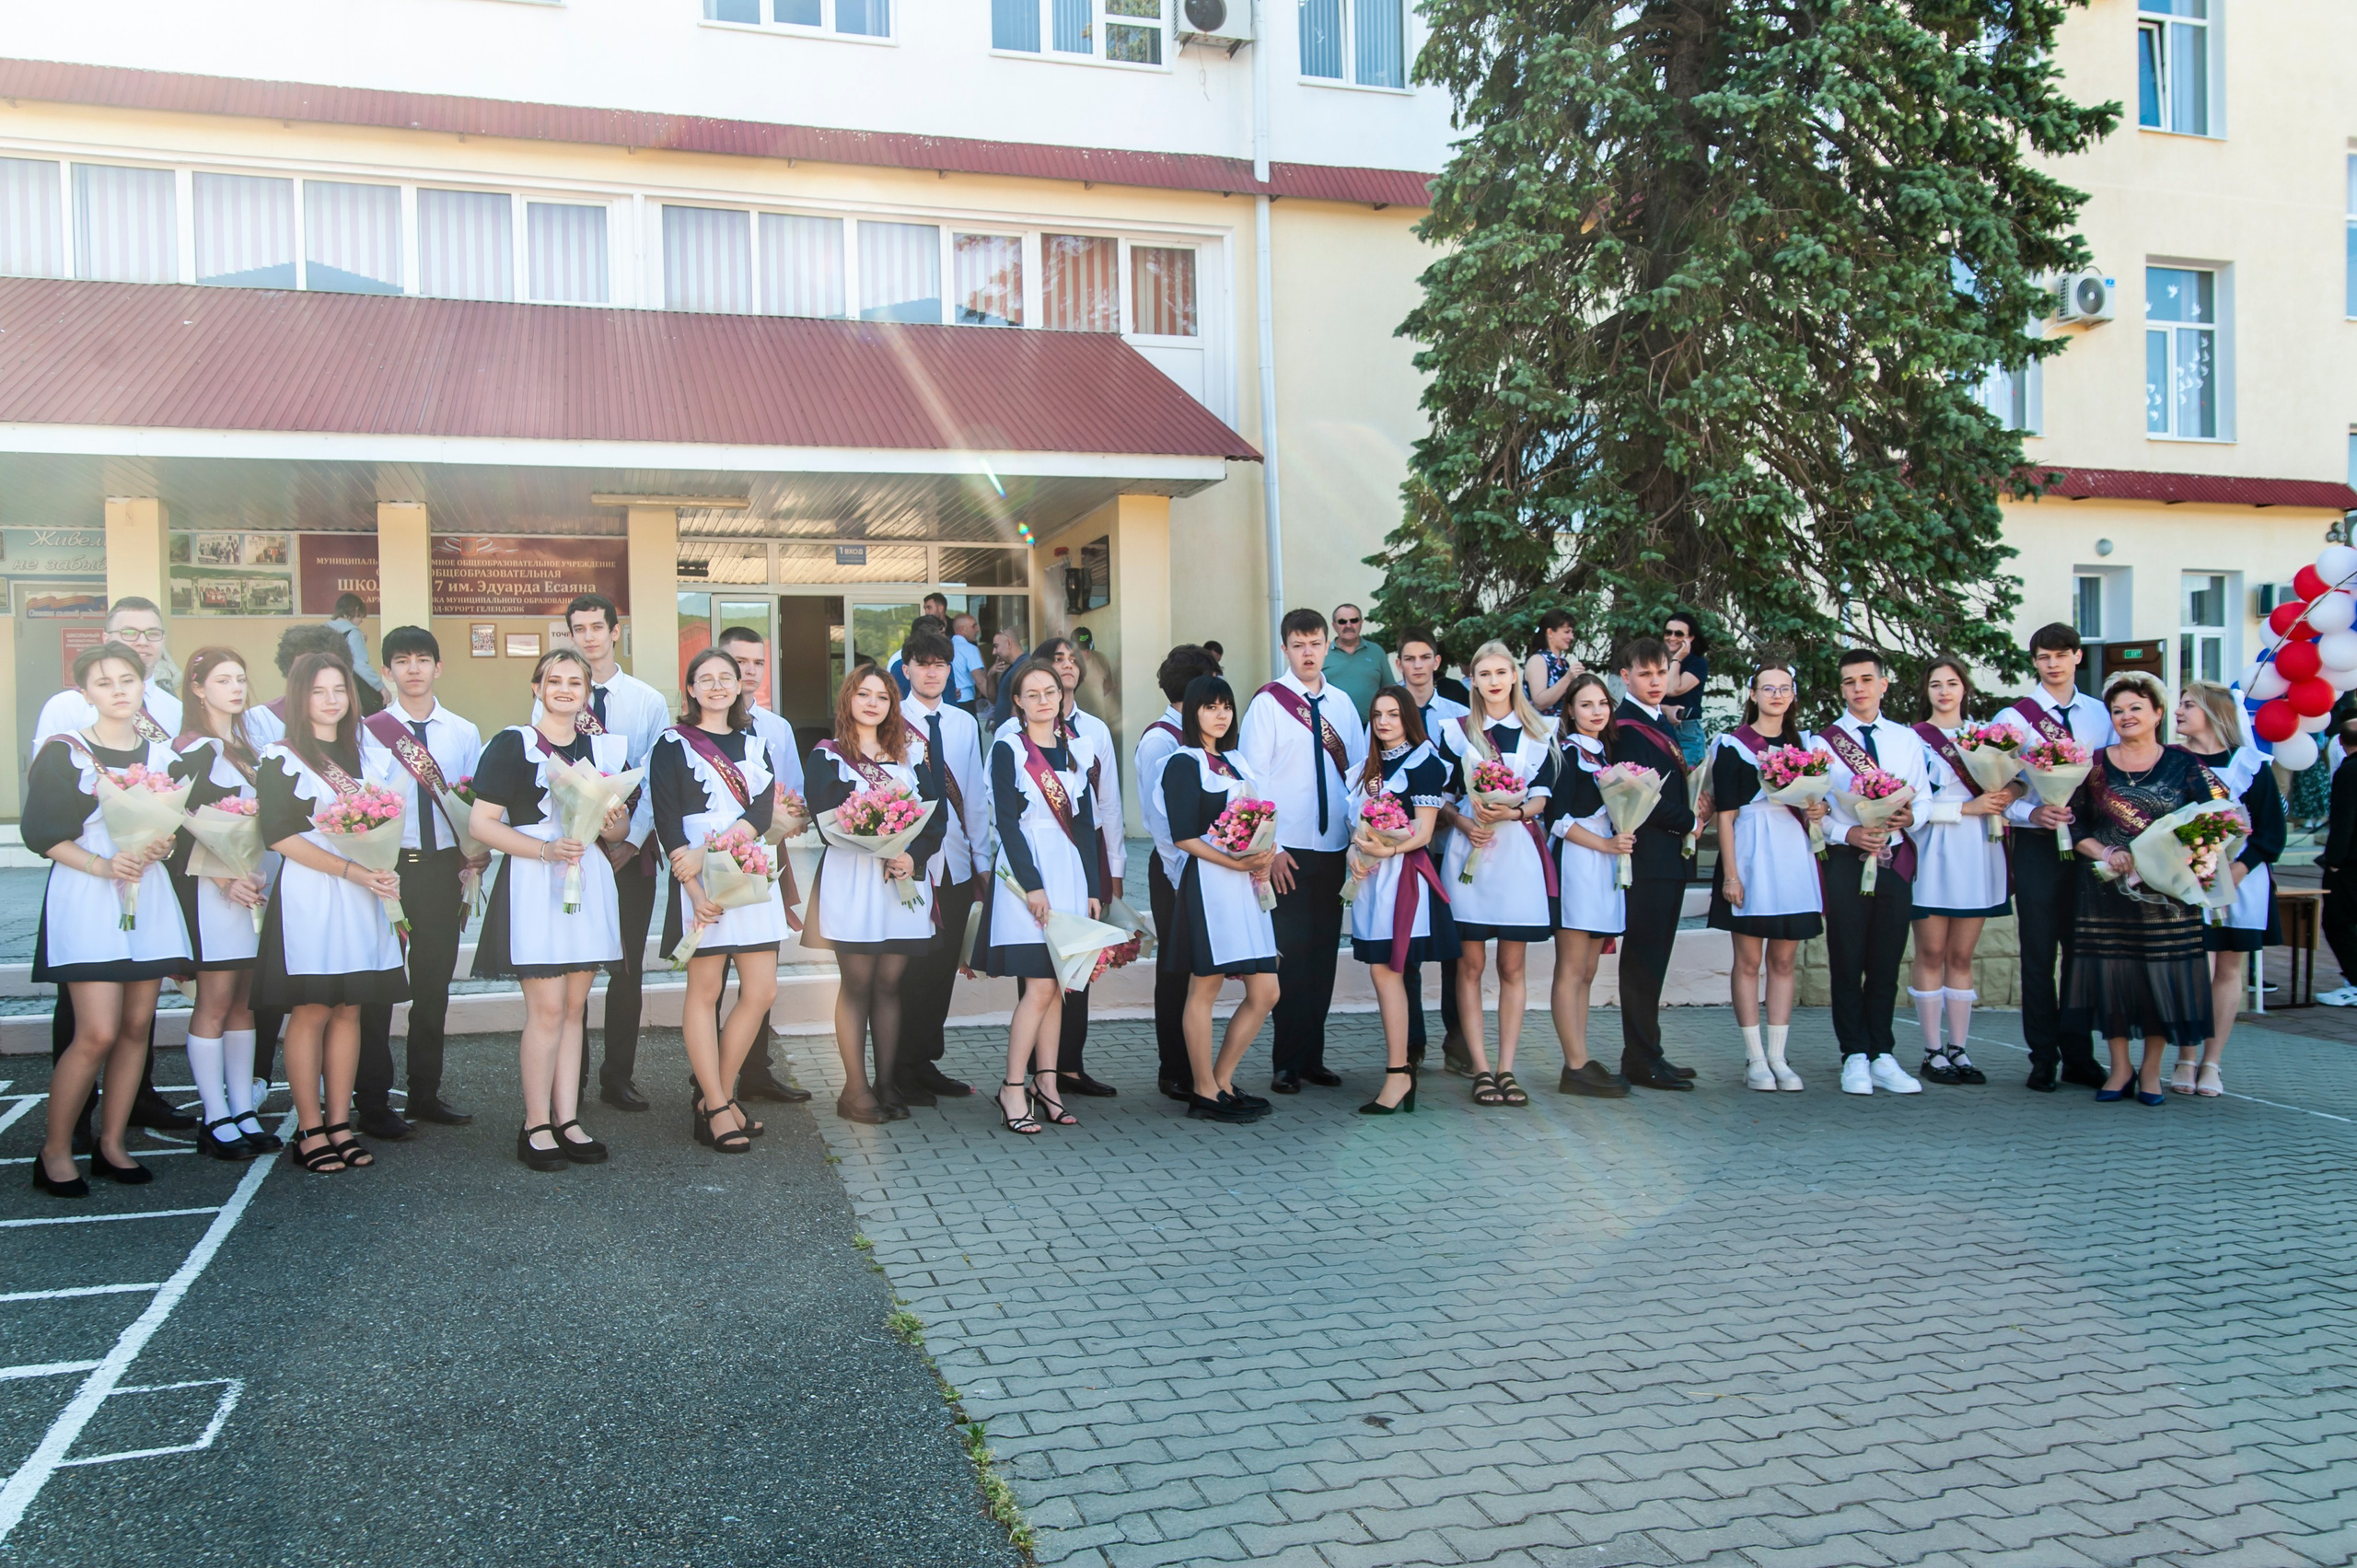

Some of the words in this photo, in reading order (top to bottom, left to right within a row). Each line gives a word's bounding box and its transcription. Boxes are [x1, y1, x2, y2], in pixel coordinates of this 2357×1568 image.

[13, 559, 39, 571] не
[457, 559, 561, 568] ОБЩЕОБРАЗОВАТЕЛЬНОЕ
[561, 560, 616, 569] УЧРЕЖДЕНИЕ
[337, 578, 380, 592] ШКО
[448, 582, 474, 592] им.
[477, 580, 540, 596] Эдуарда
[544, 580, 597, 593] Есаяна
[446, 597, 522, 605] МУНИЦИПАЛЬНОГО
[476, 605, 525, 613] ГЕЛЕНДЖИК
